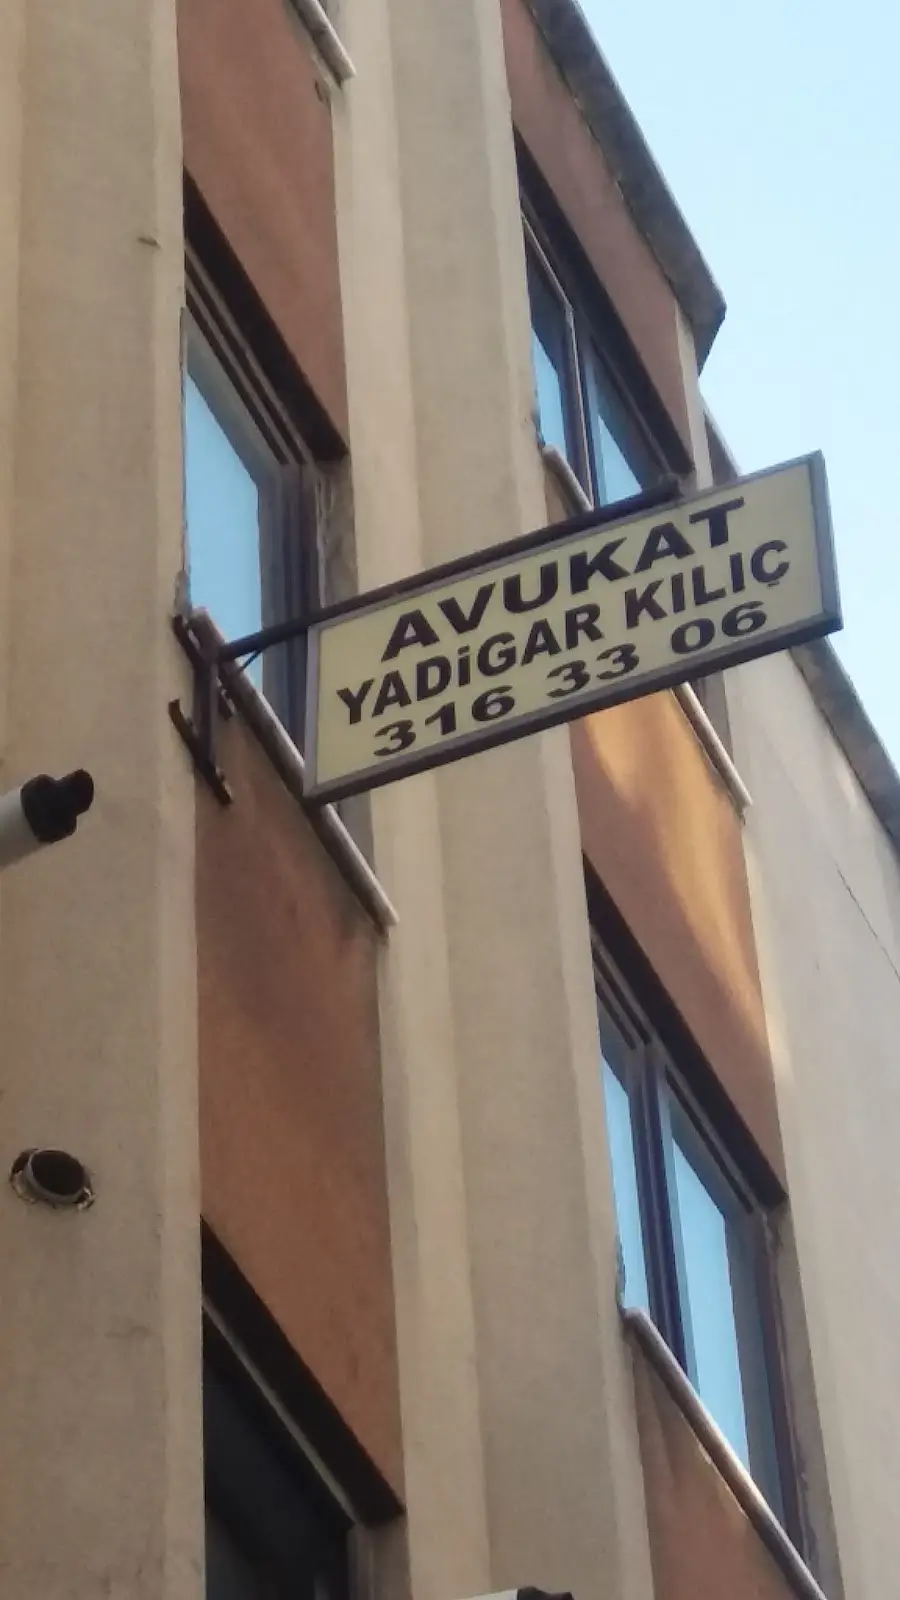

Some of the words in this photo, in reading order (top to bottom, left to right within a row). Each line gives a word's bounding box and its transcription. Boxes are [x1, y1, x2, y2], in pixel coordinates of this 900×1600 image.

[380, 497, 745, 661] AVUKAT
[624, 539, 790, 630] KILIÇ
[373, 684, 516, 757] 316
[546, 644, 640, 699] 33
[670, 600, 768, 655] 06
